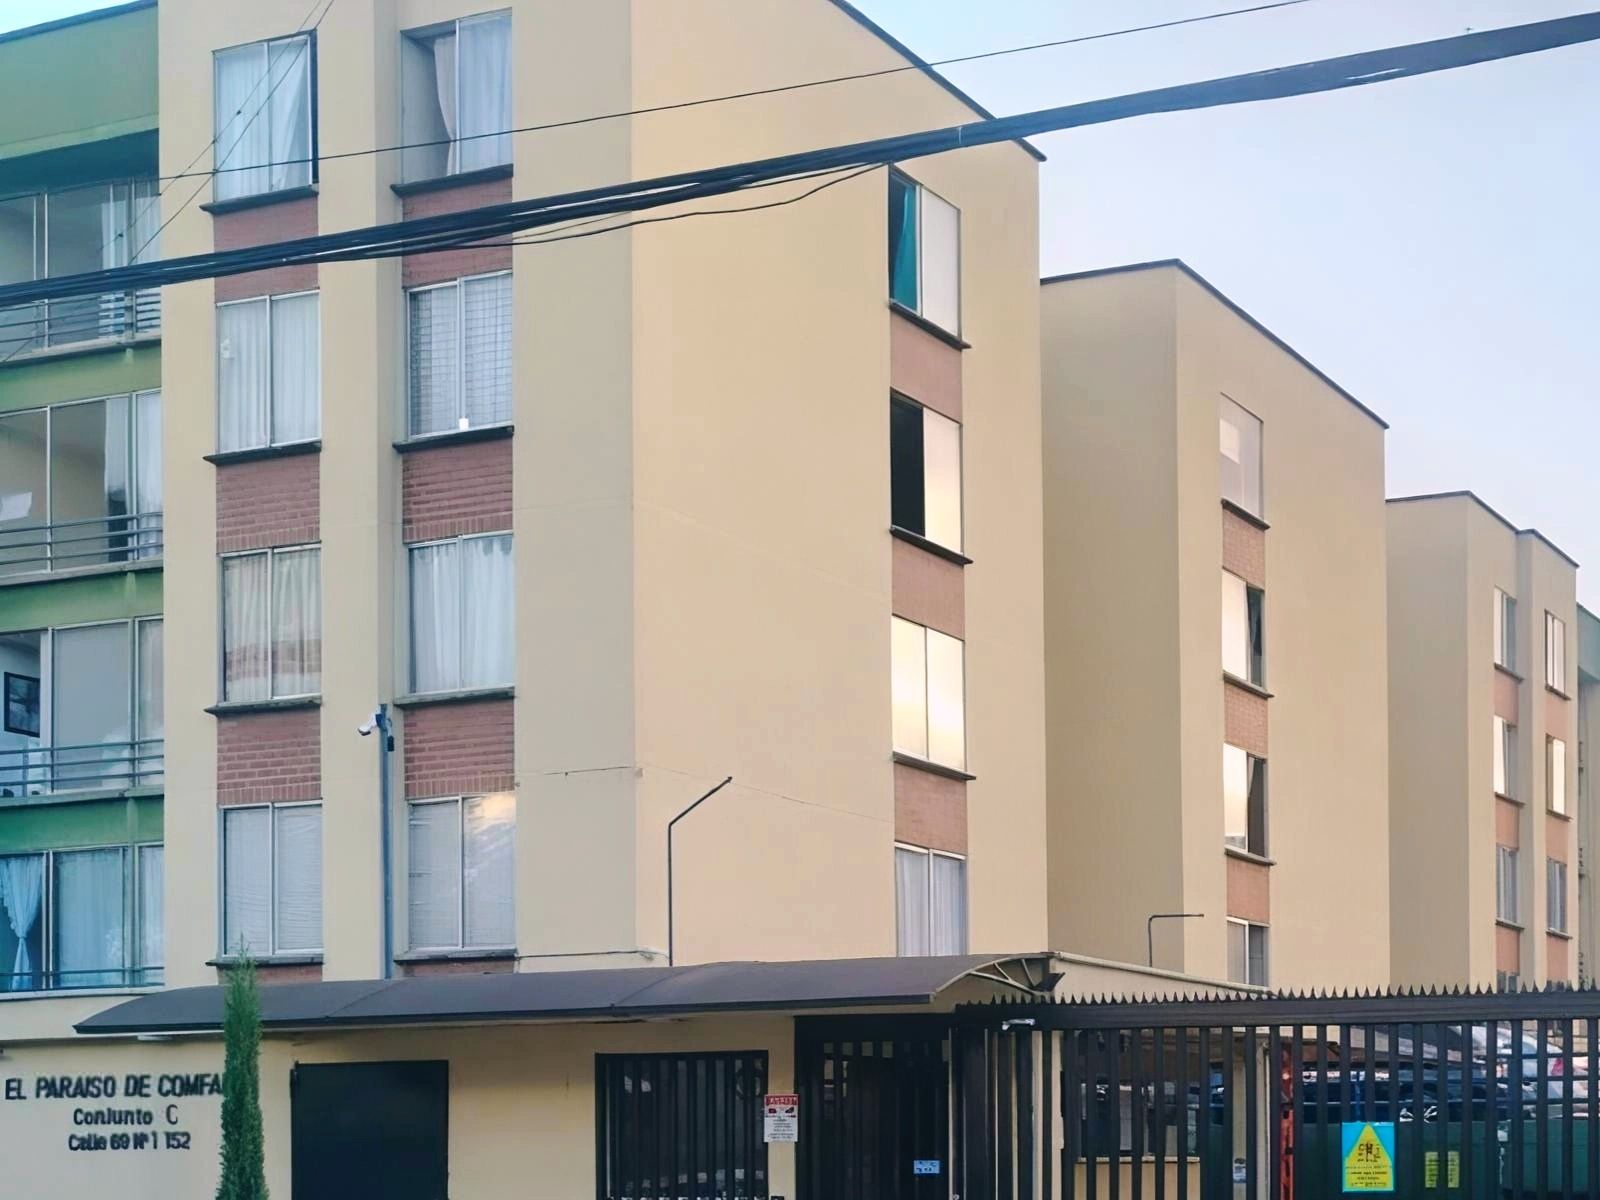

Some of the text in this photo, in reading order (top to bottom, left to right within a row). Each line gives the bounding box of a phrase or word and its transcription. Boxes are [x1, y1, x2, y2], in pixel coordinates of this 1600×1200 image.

[5, 1072, 225, 1099] EL PARAISO DE COMFA
[166, 1104, 178, 1125] C
[68, 1133, 107, 1151] Calle
